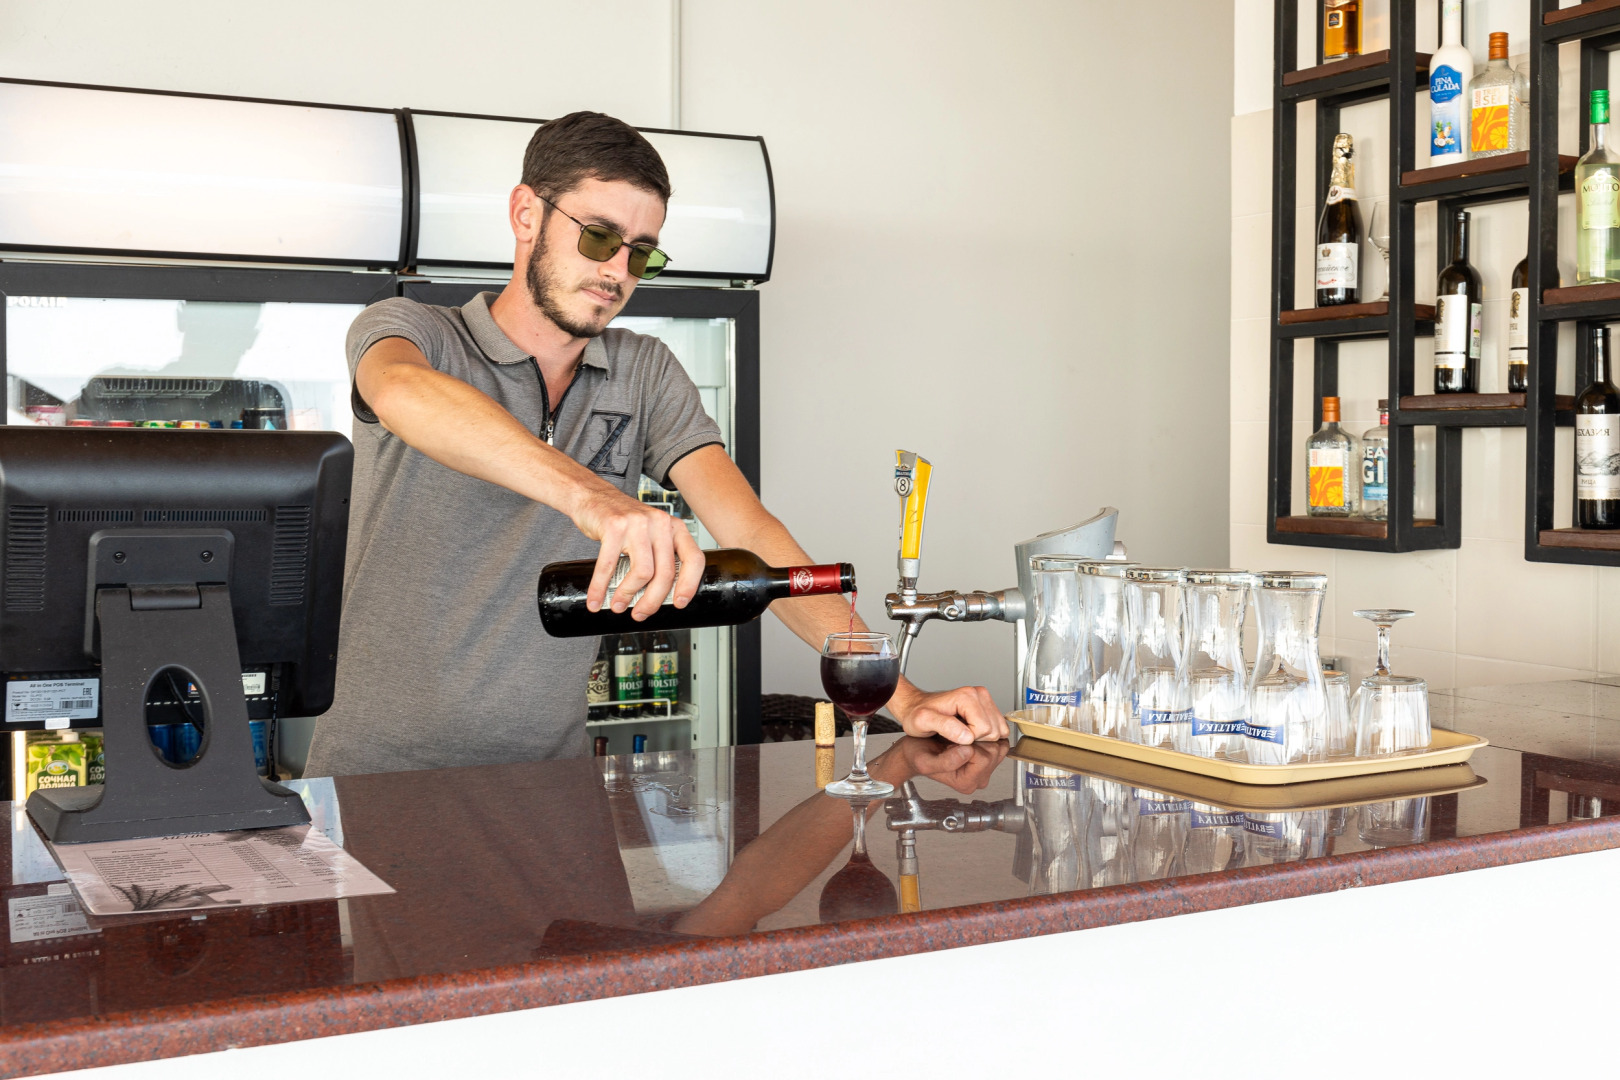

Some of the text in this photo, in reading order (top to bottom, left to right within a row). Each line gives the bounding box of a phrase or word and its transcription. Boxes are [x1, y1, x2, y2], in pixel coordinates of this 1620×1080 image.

[1431, 83, 1460, 93] COLADA
[8, 296, 67, 308] POLAIR
[899, 478, 906, 492] 8
[1029, 692, 1066, 703] BALTIKA
[1198, 722, 1242, 732] BALTIKA
[38, 774, 77, 784] СОЧНАЯ
